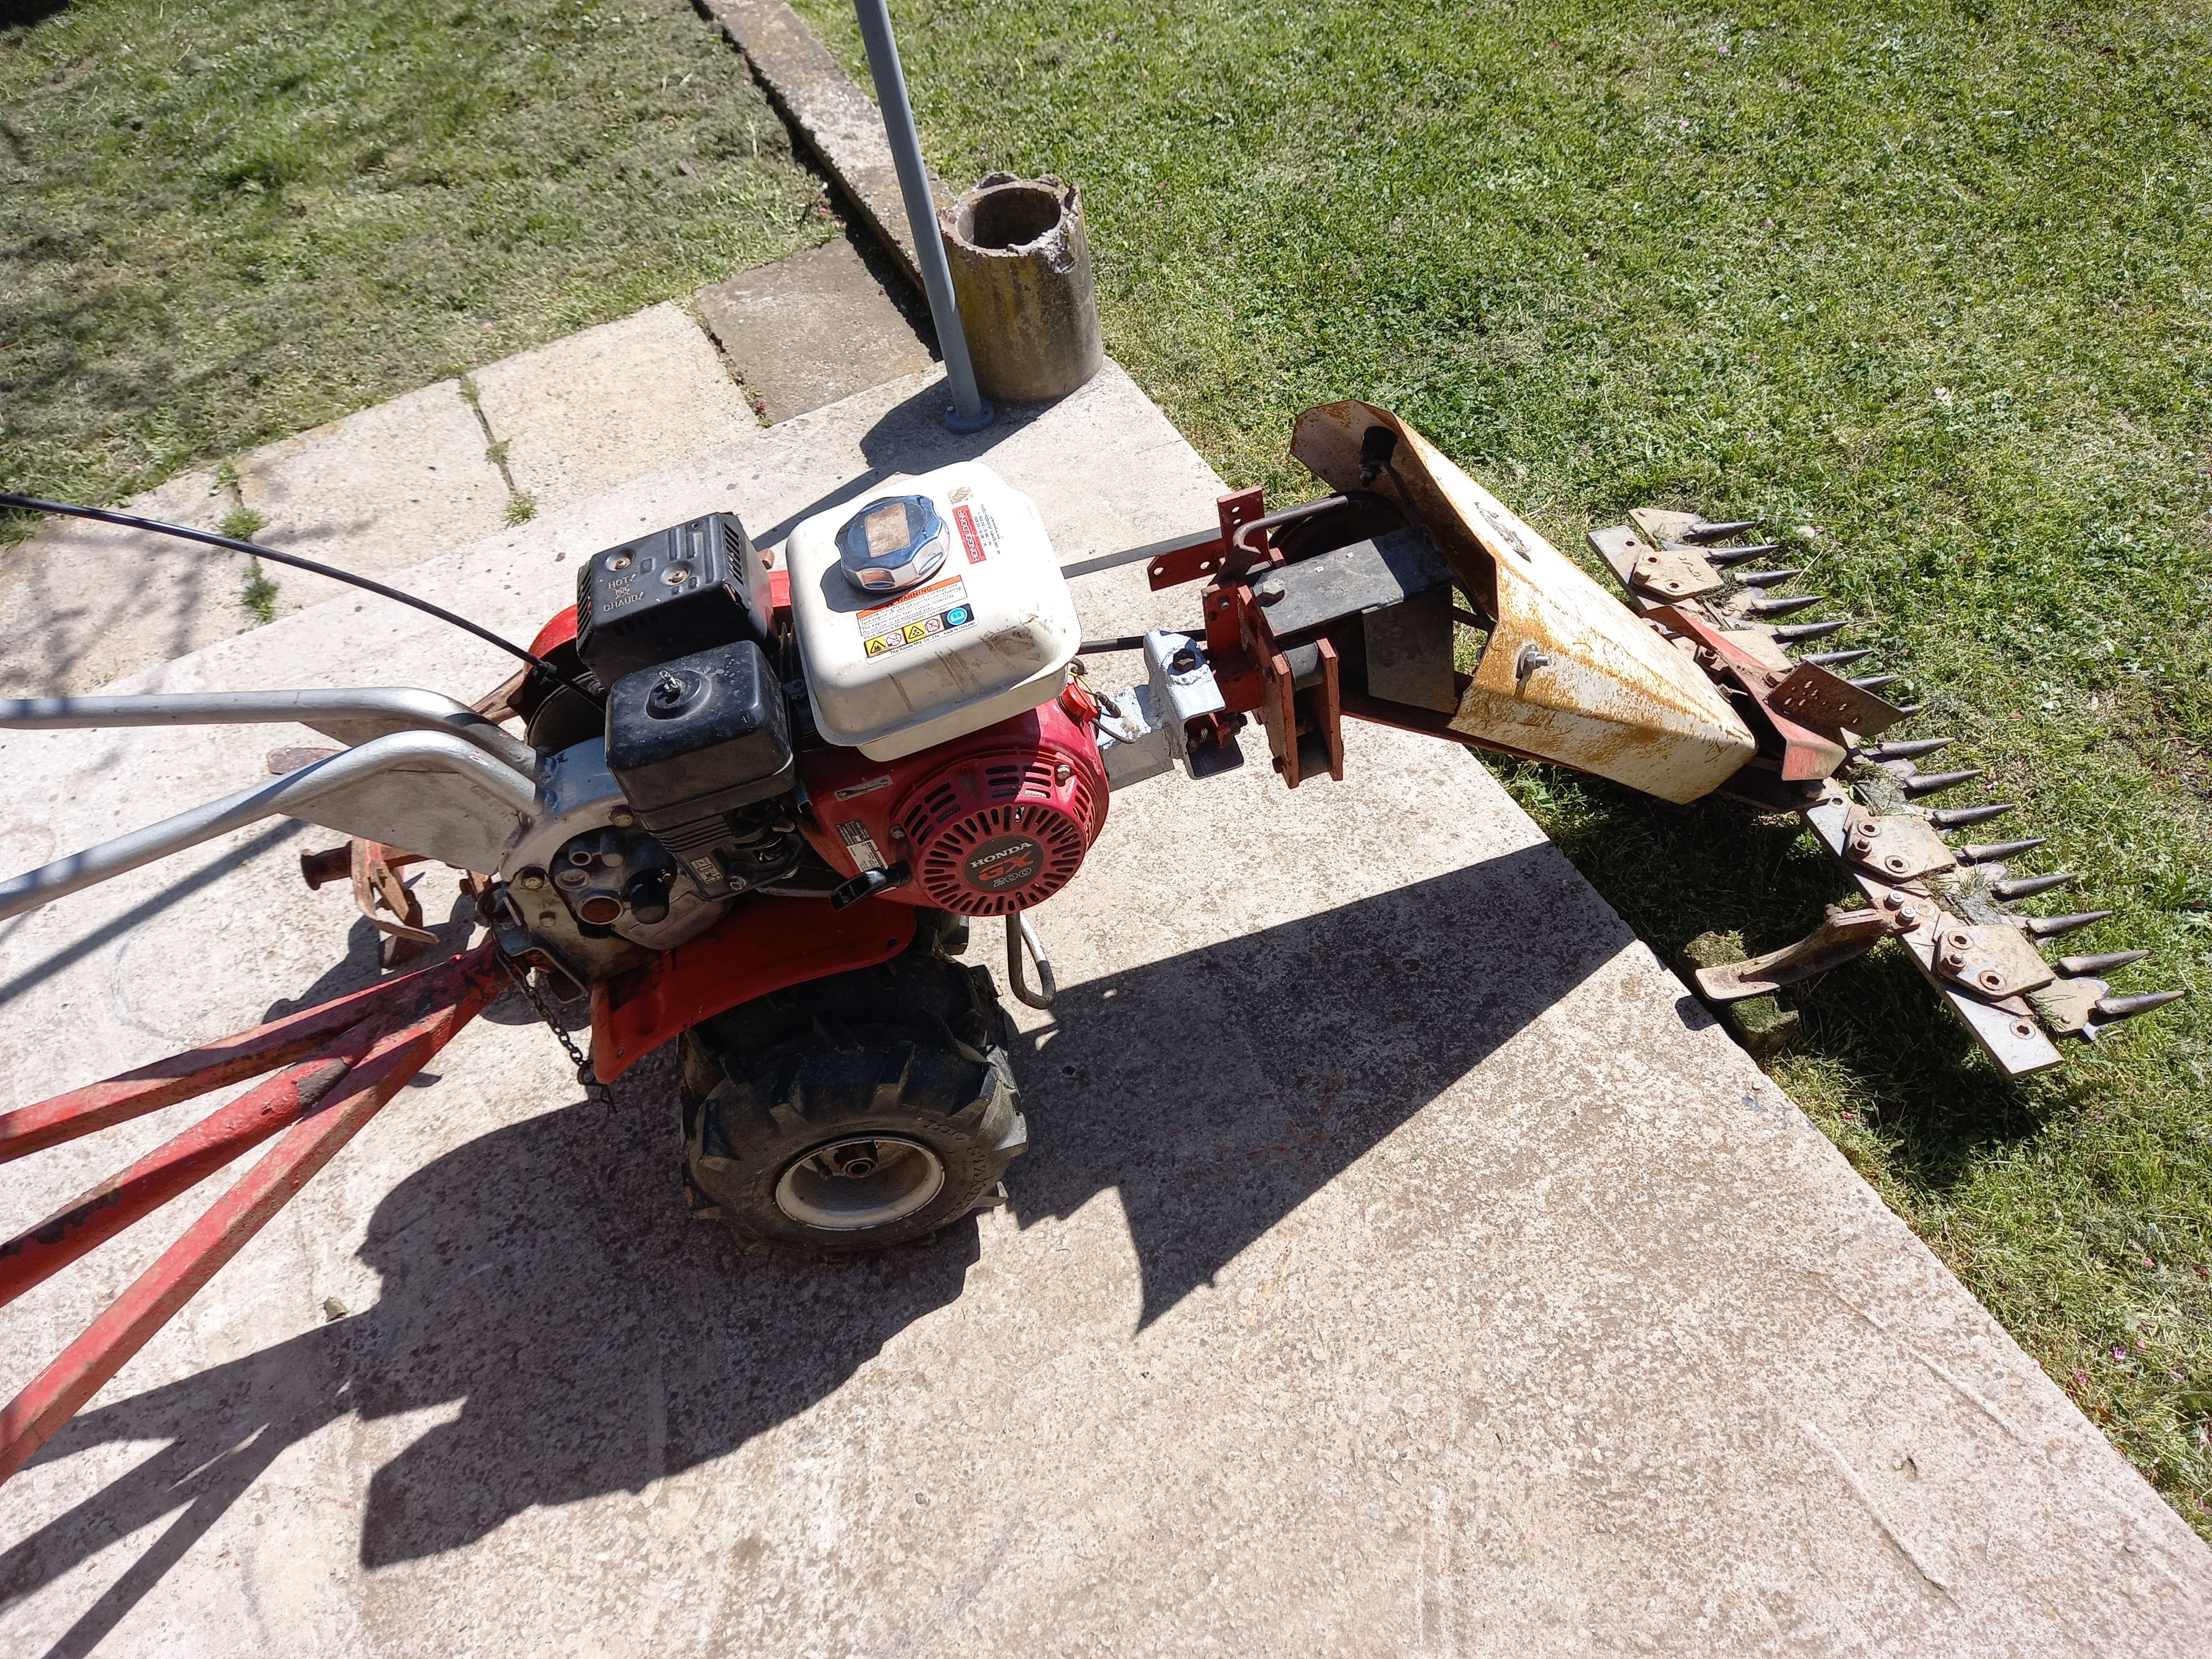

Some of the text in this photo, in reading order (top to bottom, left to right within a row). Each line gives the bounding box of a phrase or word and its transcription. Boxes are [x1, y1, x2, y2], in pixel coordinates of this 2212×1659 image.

[956, 508, 980, 562] HONGOLDONIA
[608, 573, 637, 589] HOT!
[603, 592, 644, 612] CHAUD!
[897, 586, 932, 602] WARNING
[970, 842, 1033, 868] HONDA
[978, 850, 1034, 881] GX
[993, 868, 1032, 888] 200
